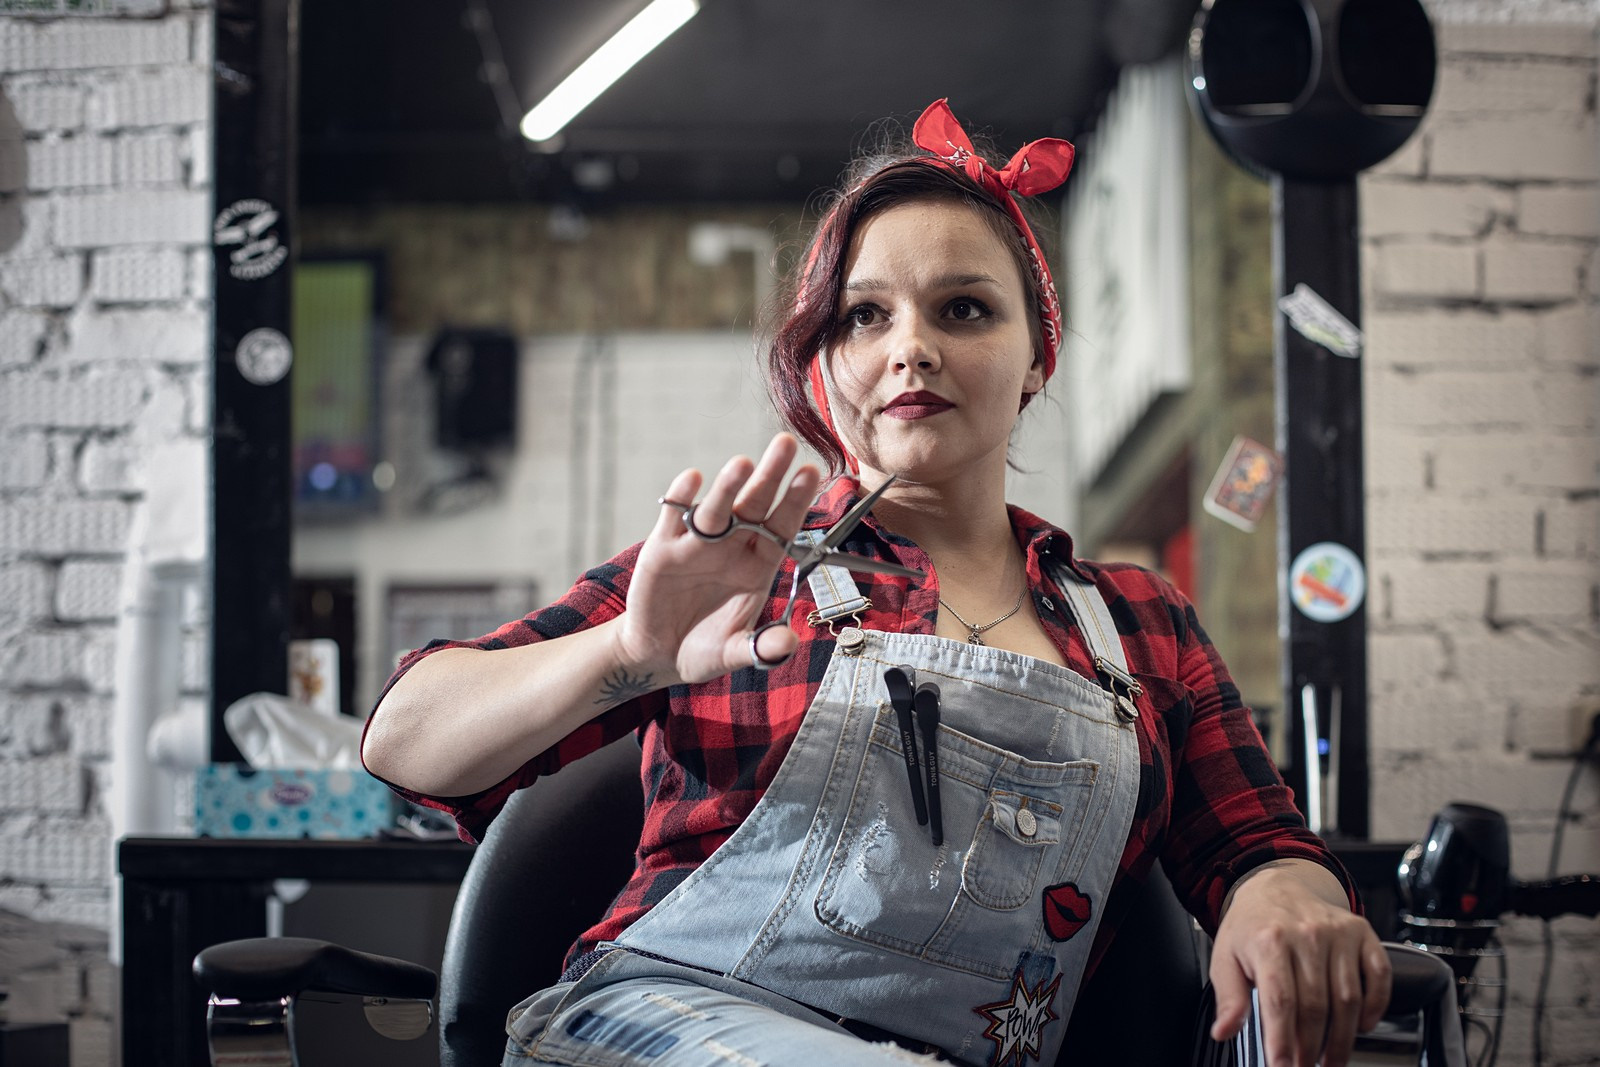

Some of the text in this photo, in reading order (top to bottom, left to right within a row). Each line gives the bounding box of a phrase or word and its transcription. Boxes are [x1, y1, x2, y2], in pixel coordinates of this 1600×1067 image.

[904, 730, 915, 767] TONI&GUY
[928, 750, 937, 787] TONI&GUY
[1006, 1006, 1045, 1043] POW!
